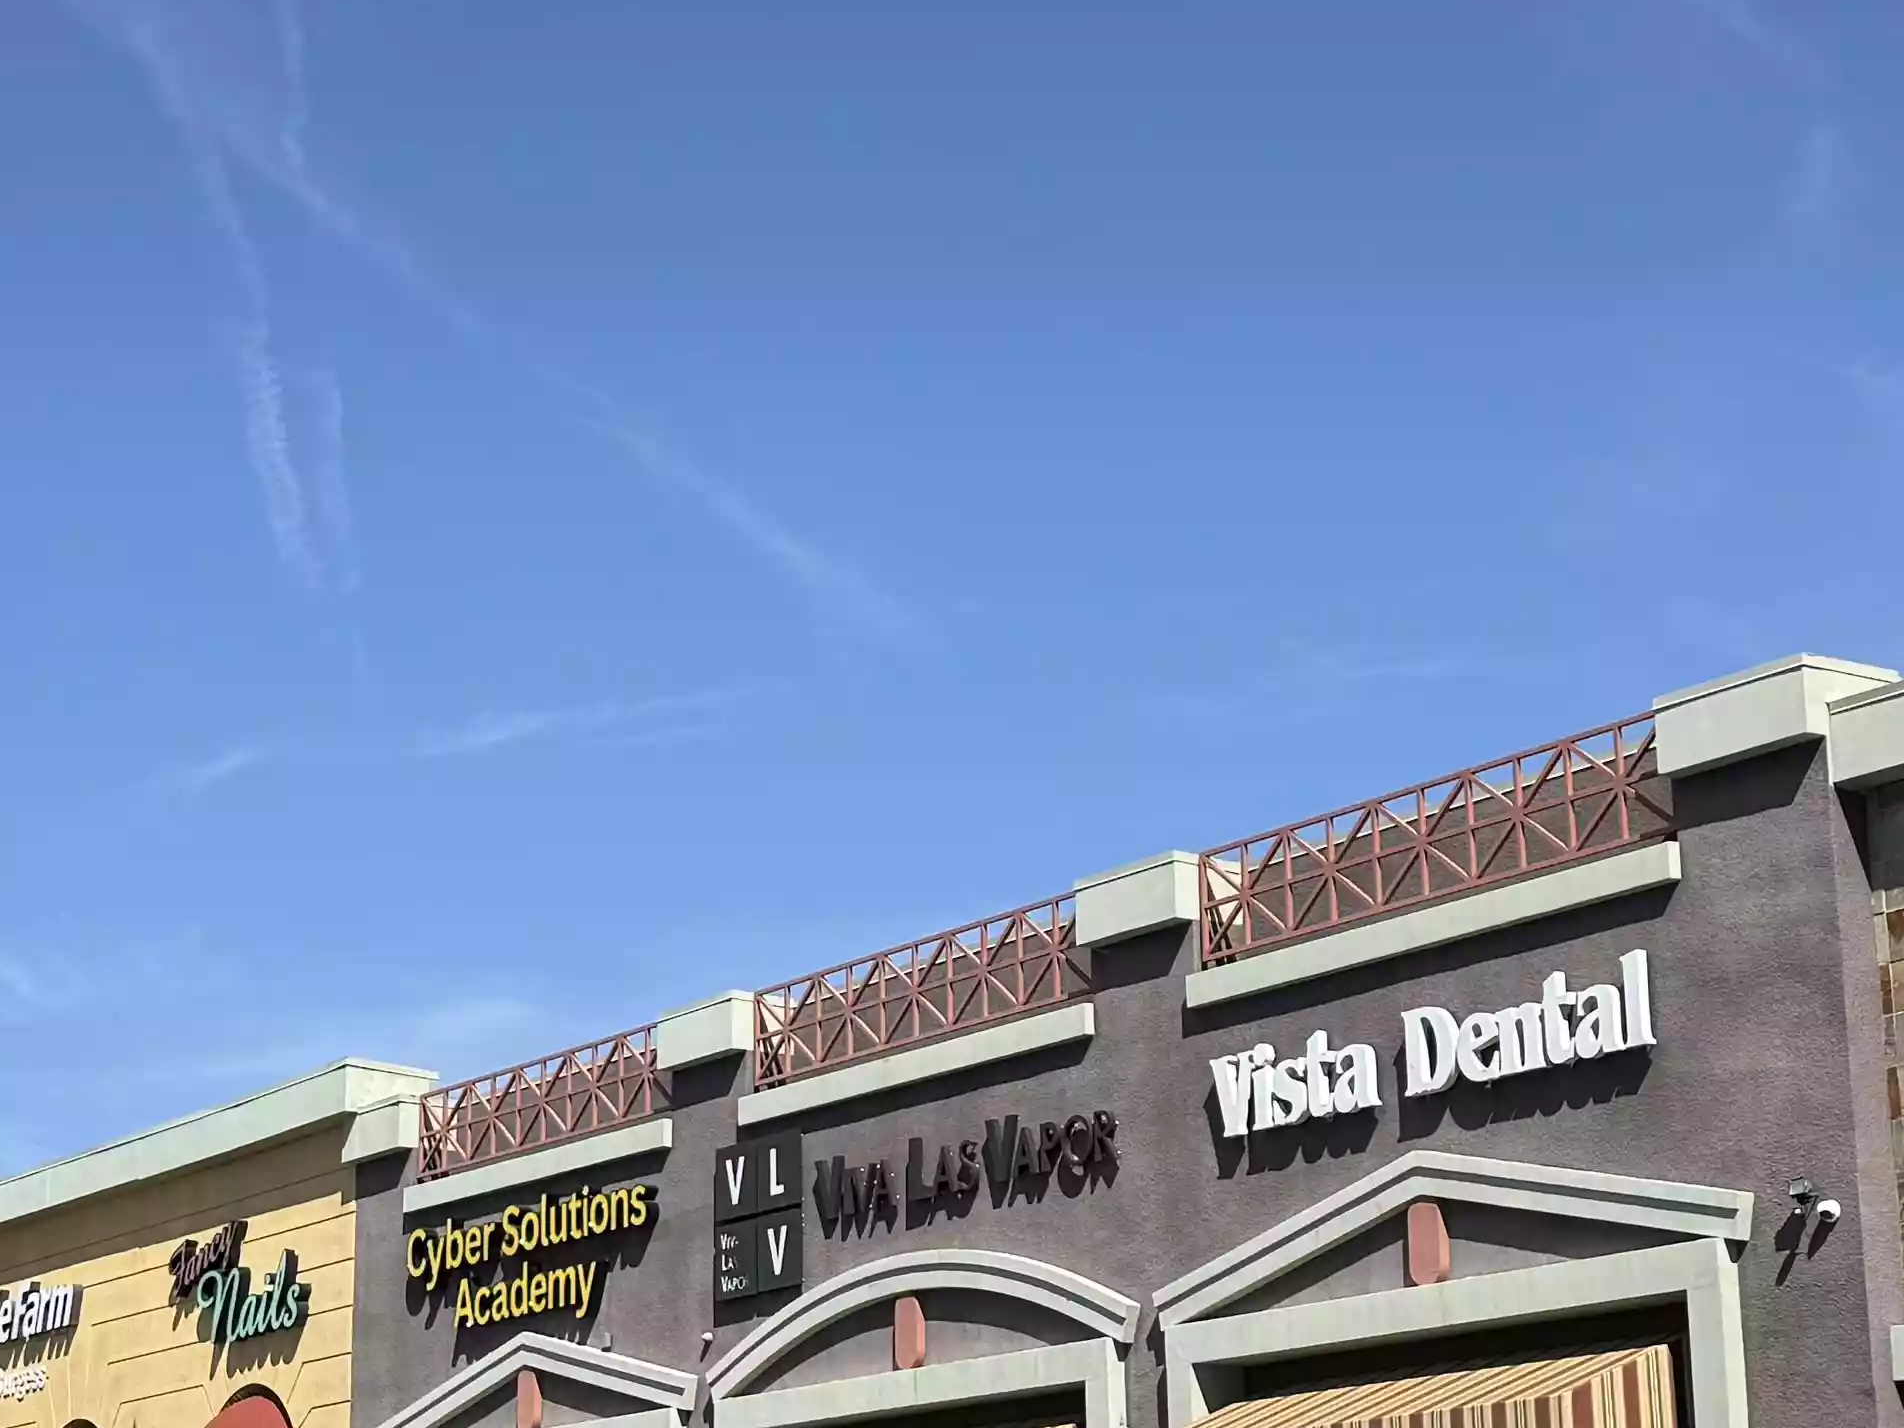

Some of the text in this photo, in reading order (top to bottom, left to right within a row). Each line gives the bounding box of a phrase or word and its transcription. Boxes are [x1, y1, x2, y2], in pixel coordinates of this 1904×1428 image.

[1209, 948, 1657, 1138] Vista Dental
[907, 1137, 980, 1201] LAS
[172, 1220, 241, 1301] Fancy
[407, 1184, 647, 1291] Cyber Solutions
[197, 1248, 301, 1345] Nails
[454, 1260, 596, 1329] Academy
